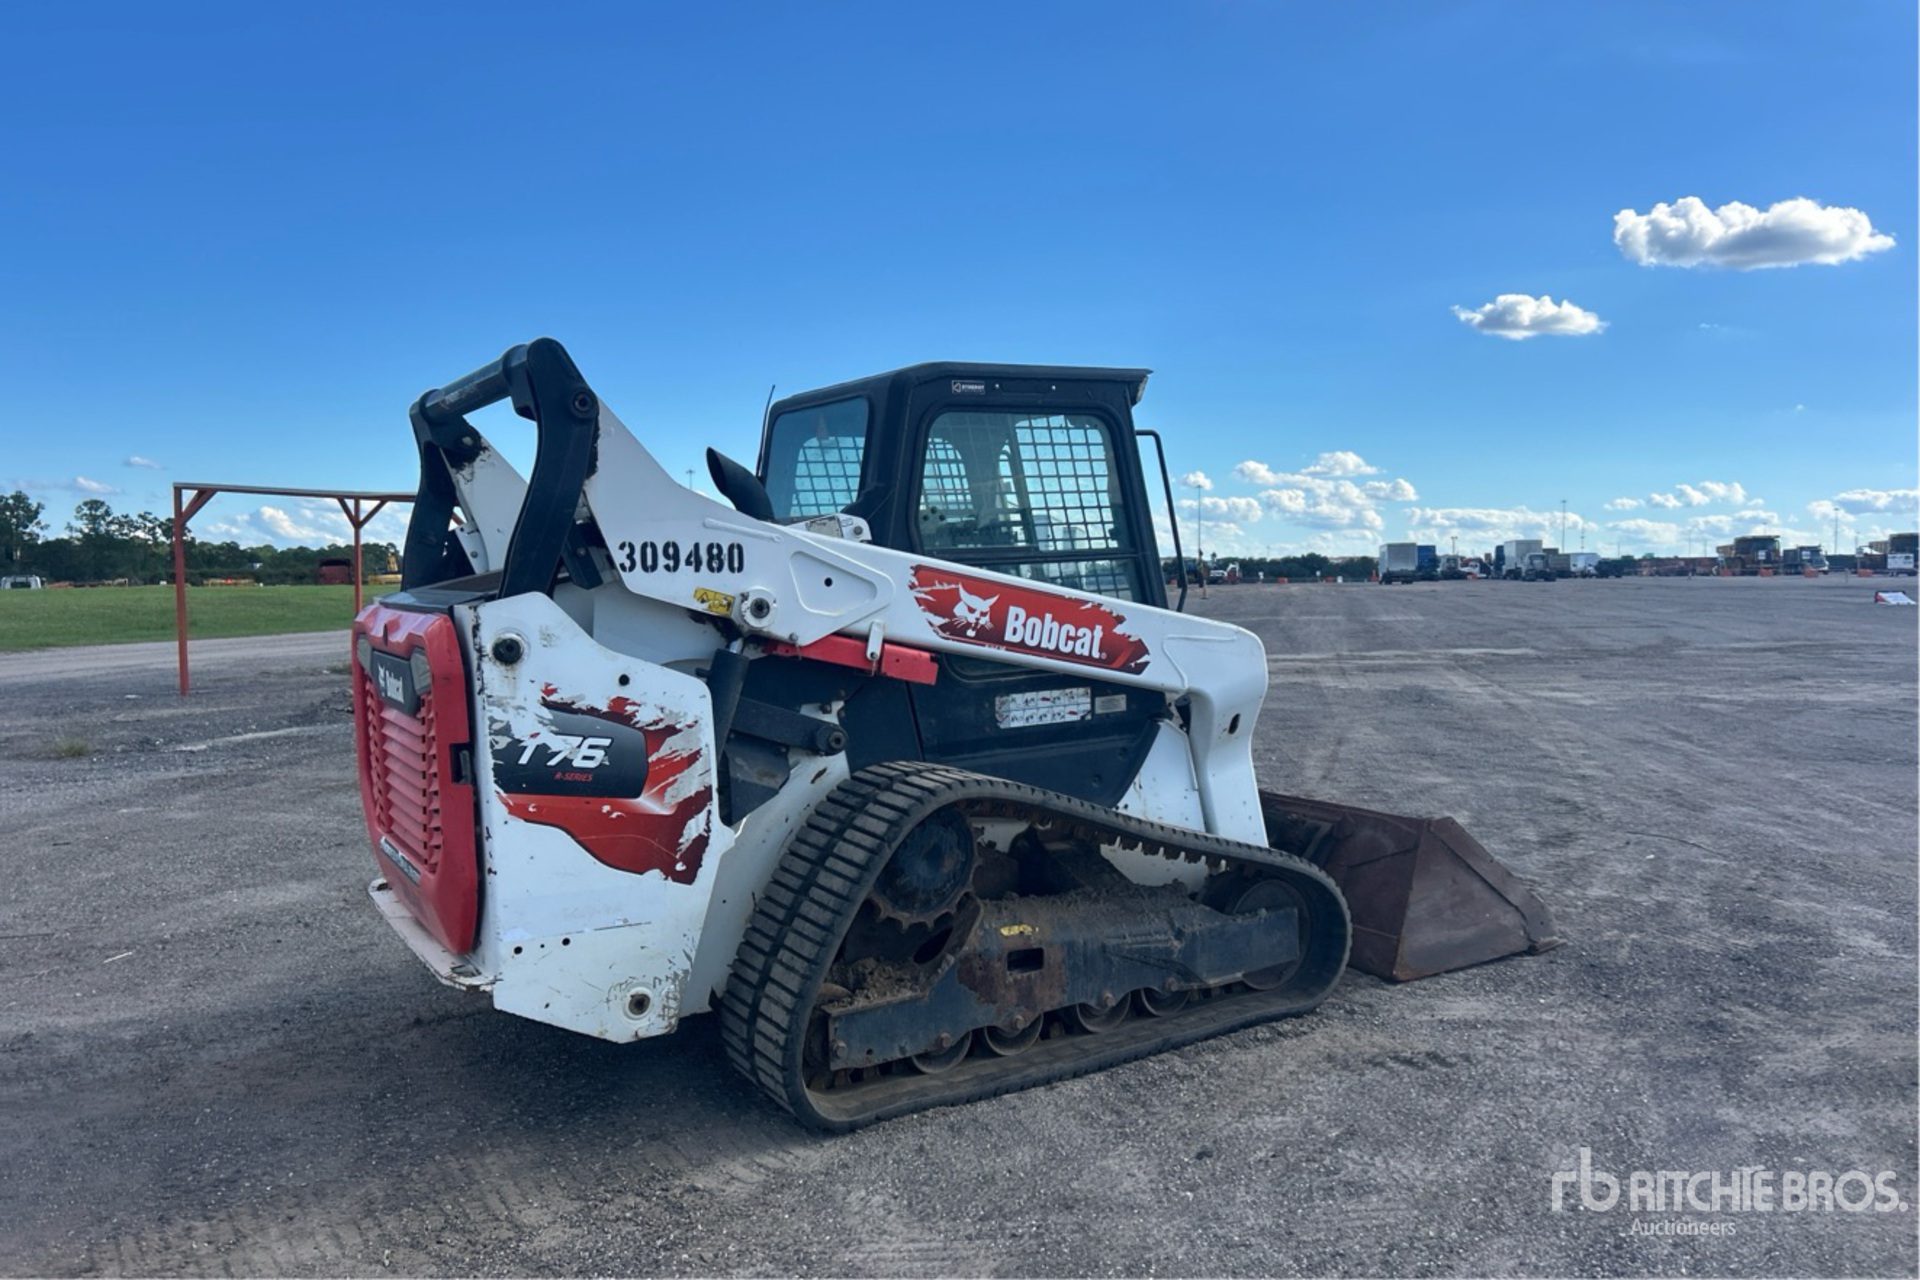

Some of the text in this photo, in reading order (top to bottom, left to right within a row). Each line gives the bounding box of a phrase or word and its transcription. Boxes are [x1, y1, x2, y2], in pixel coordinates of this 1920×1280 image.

[618, 541, 744, 573] 309480
[1004, 605, 1104, 660] Bobcat
[554, 771, 593, 782] R-SERIES
